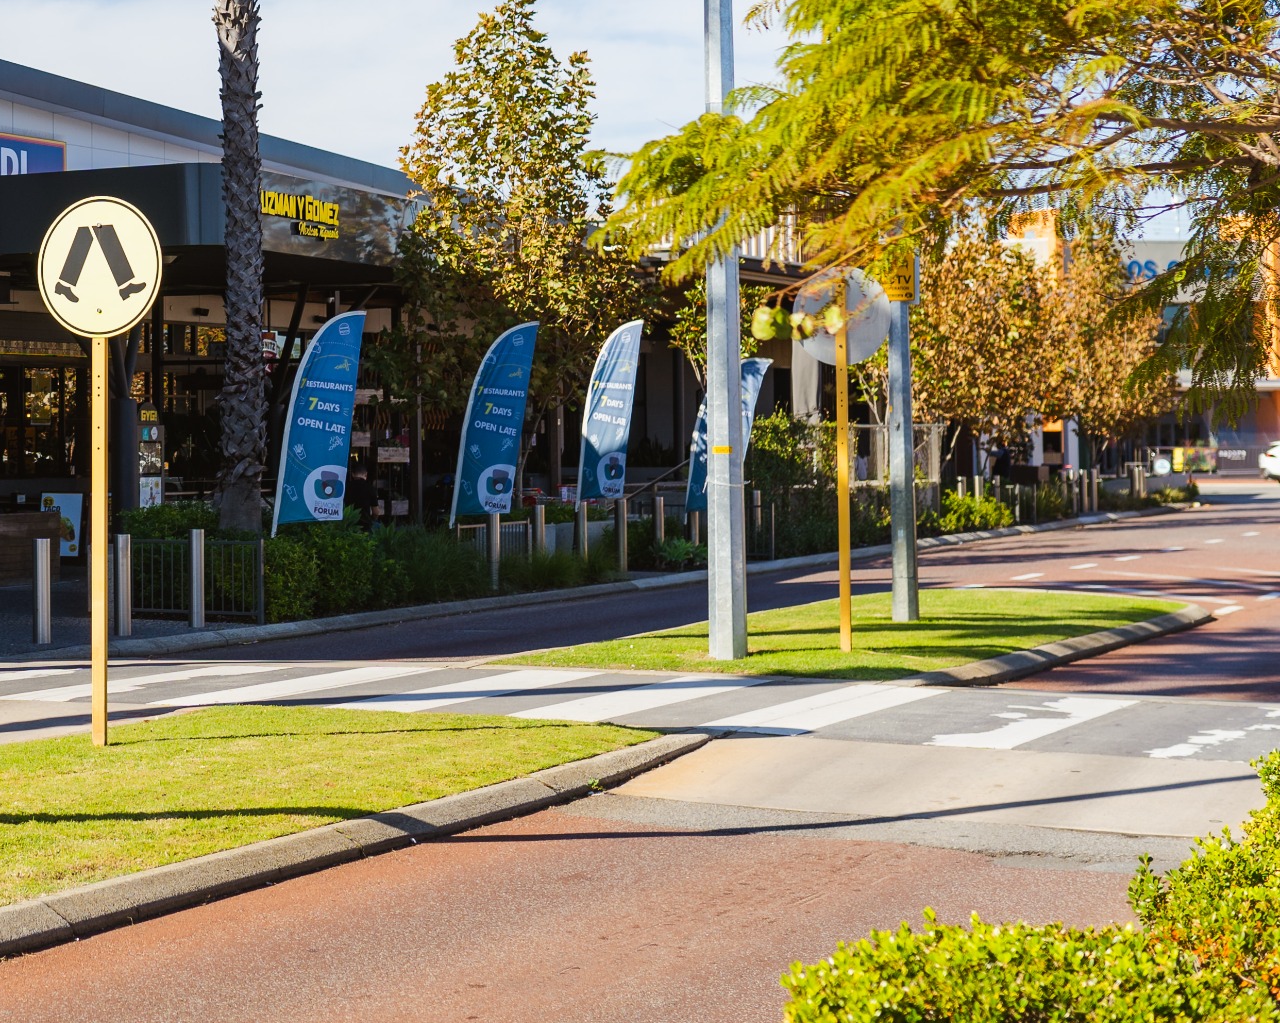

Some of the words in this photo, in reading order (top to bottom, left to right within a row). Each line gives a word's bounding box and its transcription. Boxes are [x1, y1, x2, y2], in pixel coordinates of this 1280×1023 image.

[261, 190, 296, 218] UZMAN
[297, 196, 304, 219] Y
[305, 195, 339, 226] GOMEZ
[306, 380, 354, 392] RESTAURANTS
[309, 397, 319, 410] 7
[317, 401, 340, 413] DAYS
[600, 395, 608, 407] 7
[606, 399, 624, 409] DAYS
[484, 402, 494, 415] 7
[492, 406, 513, 417] DAYS
[593, 412, 611, 423] OPEN
[297, 417, 323, 430] OPEN
[325, 422, 346, 435] LATE
[475, 420, 497, 432] OPEN
[498, 425, 517, 437] LATE
[314, 507, 339, 517] FORUM
[485, 501, 507, 510] FORUM
